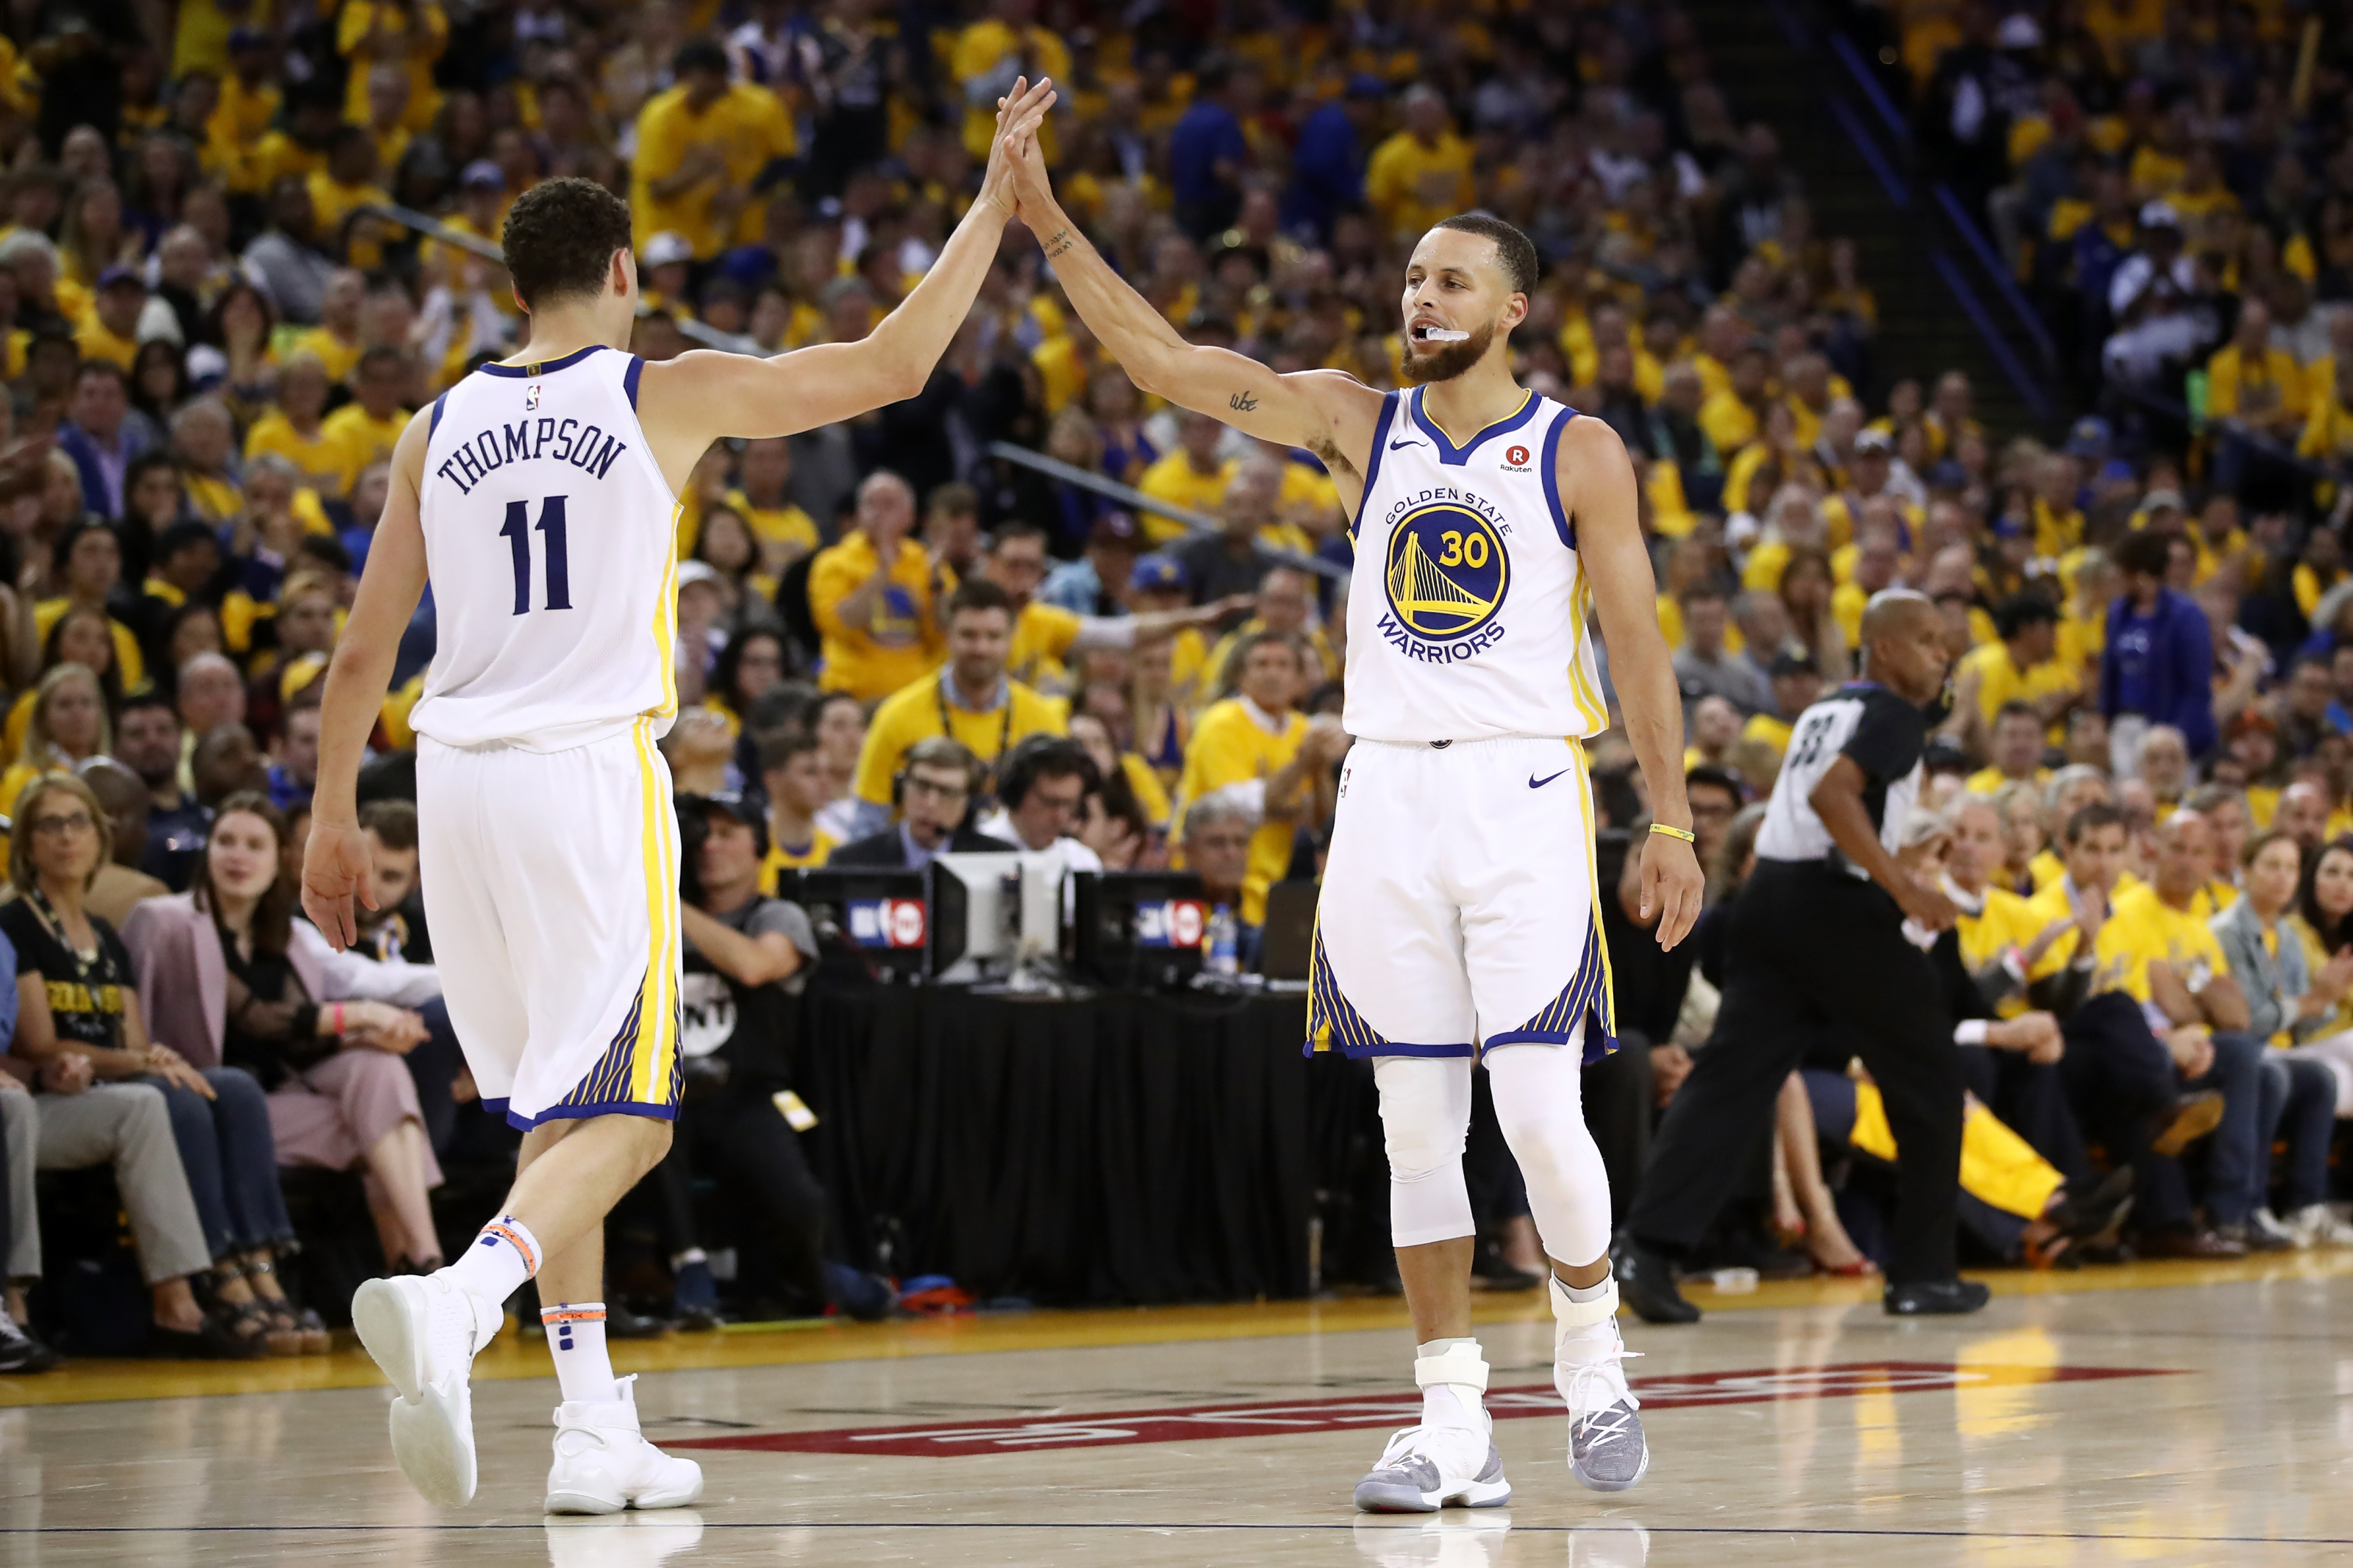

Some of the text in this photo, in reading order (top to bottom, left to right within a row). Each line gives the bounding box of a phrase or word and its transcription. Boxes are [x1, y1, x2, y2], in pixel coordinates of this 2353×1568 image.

[437, 418, 626, 495] THOMPSON
[1500, 464, 1532, 473] Rakuten
[1512, 449, 1524, 462] R
[1385, 487, 1513, 537] GOLDEN STATE
[499, 495, 573, 616] 11
[1439, 530, 1489, 568] 30
[1377, 612, 1505, 664] WARRIORS
[683, 995, 730, 1030] NT
